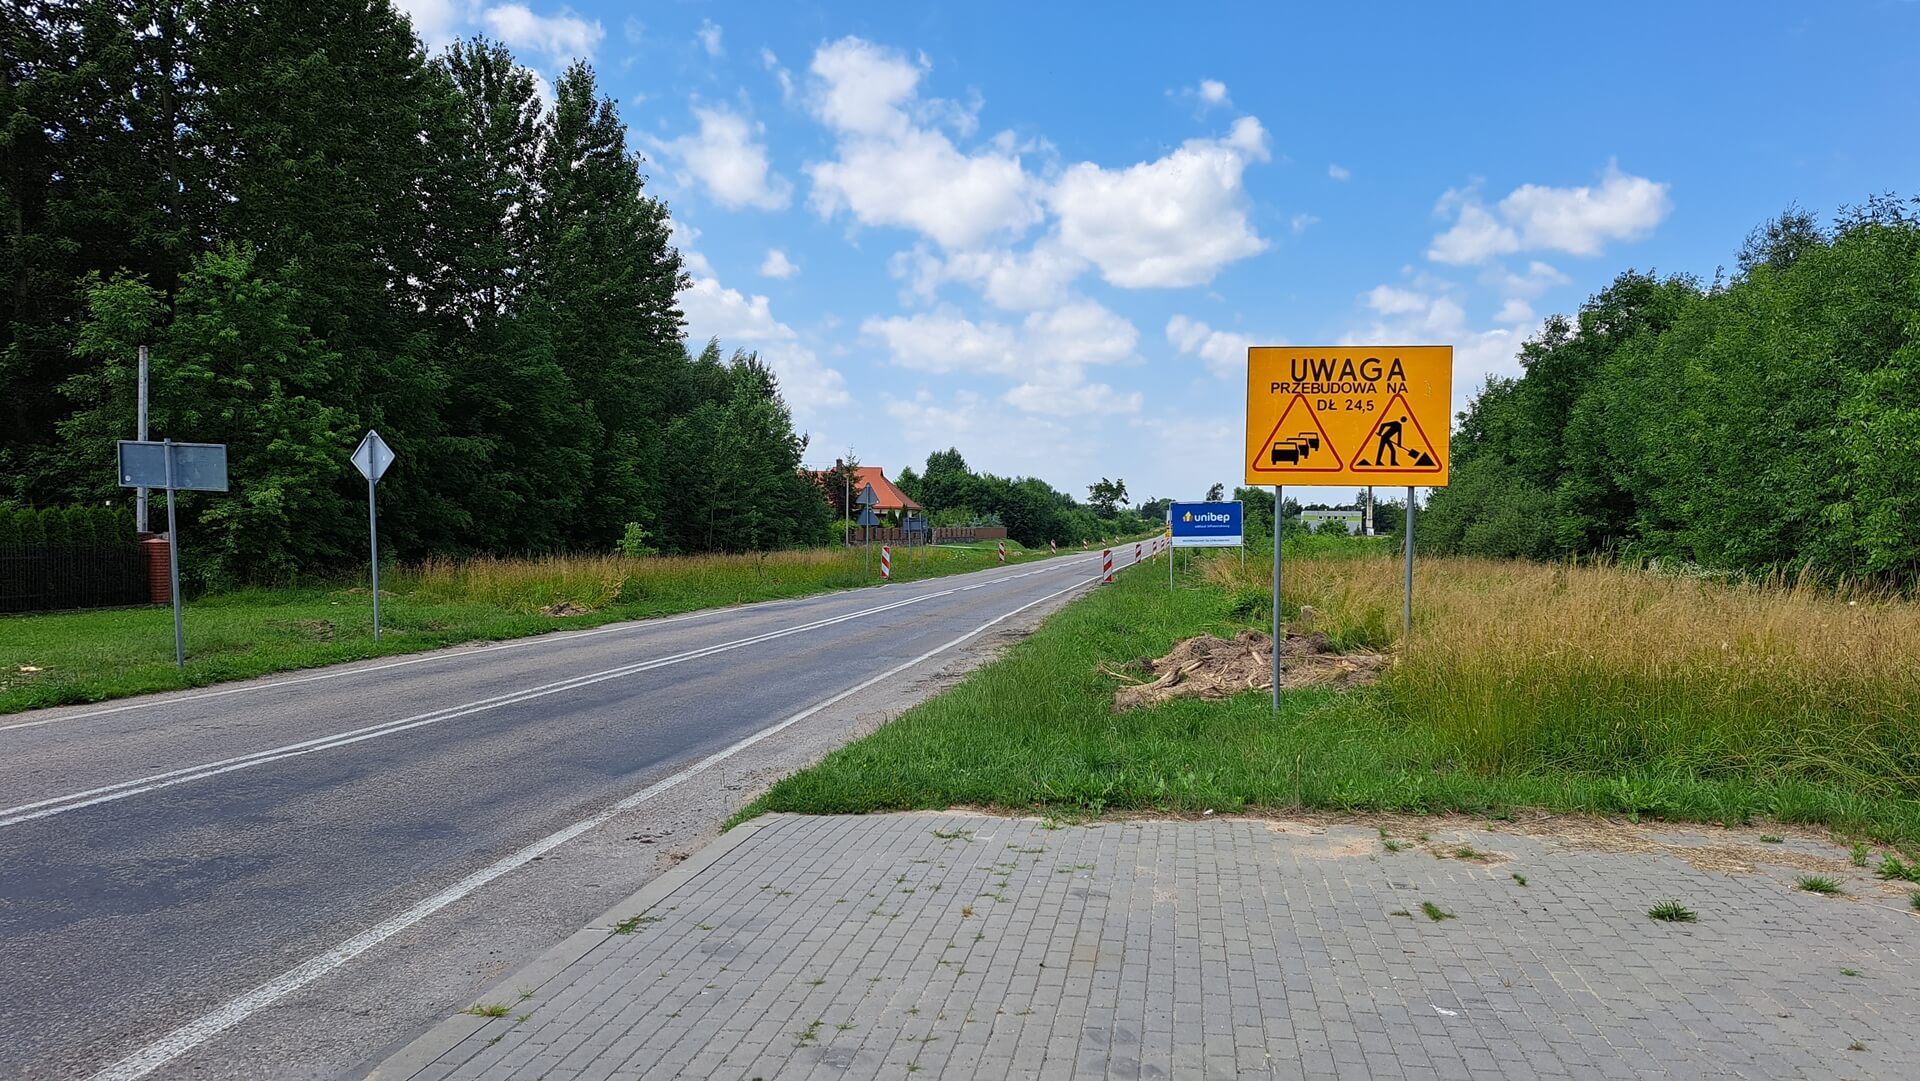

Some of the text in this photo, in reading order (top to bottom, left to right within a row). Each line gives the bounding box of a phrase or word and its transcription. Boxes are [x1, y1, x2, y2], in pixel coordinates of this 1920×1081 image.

[1291, 358, 1406, 382] UWAGA
[1271, 382, 1408, 394] PRZEBUDOWA NA
[1317, 399, 1374, 414] DŁ 24,5
[1194, 512, 1230, 523] unibep
